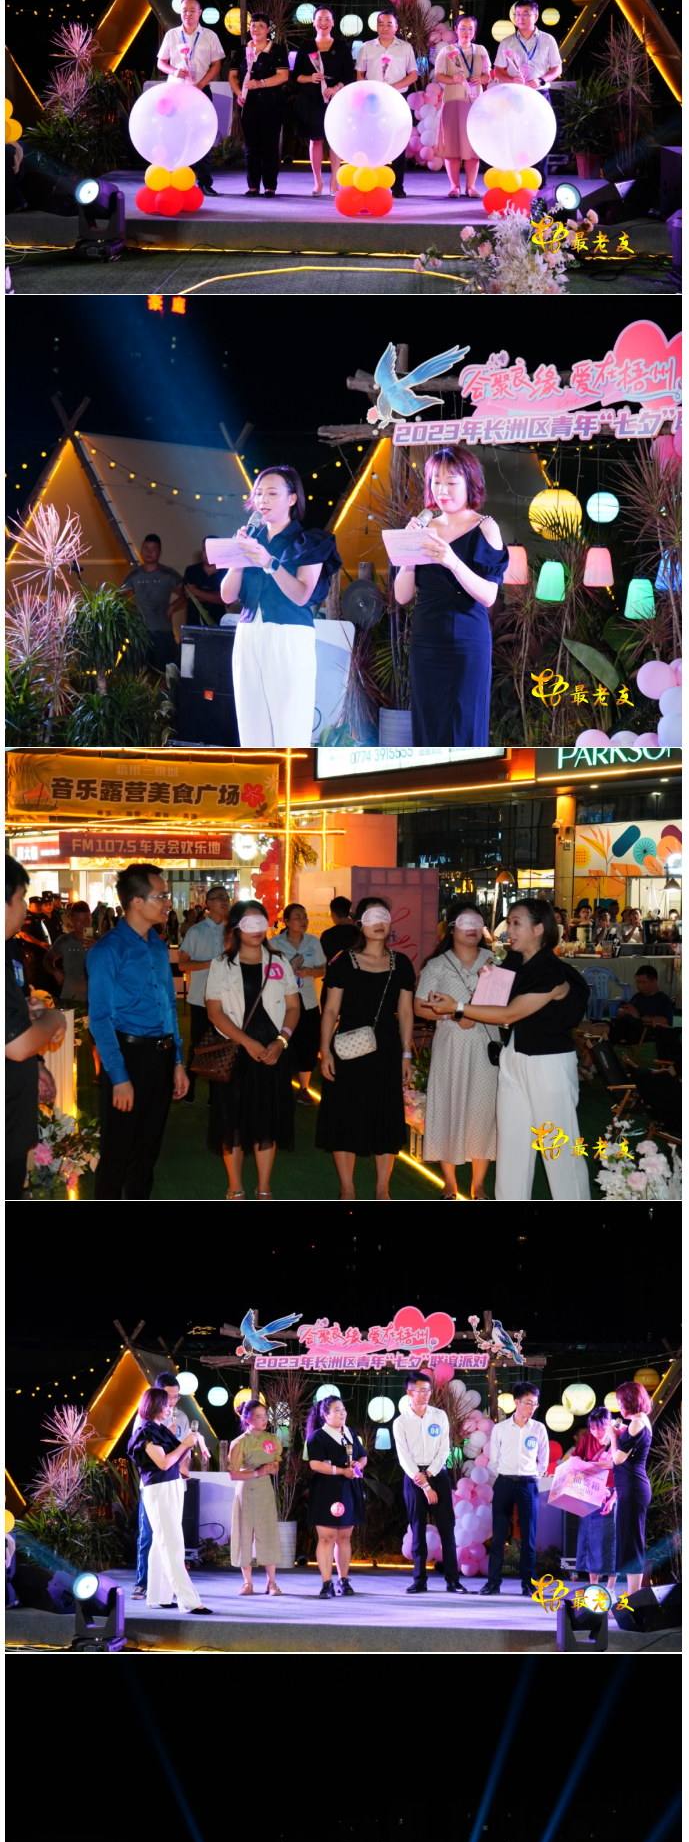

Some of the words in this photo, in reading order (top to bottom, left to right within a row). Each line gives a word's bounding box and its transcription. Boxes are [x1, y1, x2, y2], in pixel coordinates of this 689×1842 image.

[462, 359, 562, 403] 会聚良缘
[572, 353, 676, 399] 爱在梧州
[116, 763, 180, 778] 梧州三祺城
[50, 776, 241, 806] 音乐露营美食广场
[72, 838, 137, 854] FM107.5
[139, 839, 221, 856] 车友会欢乐地
